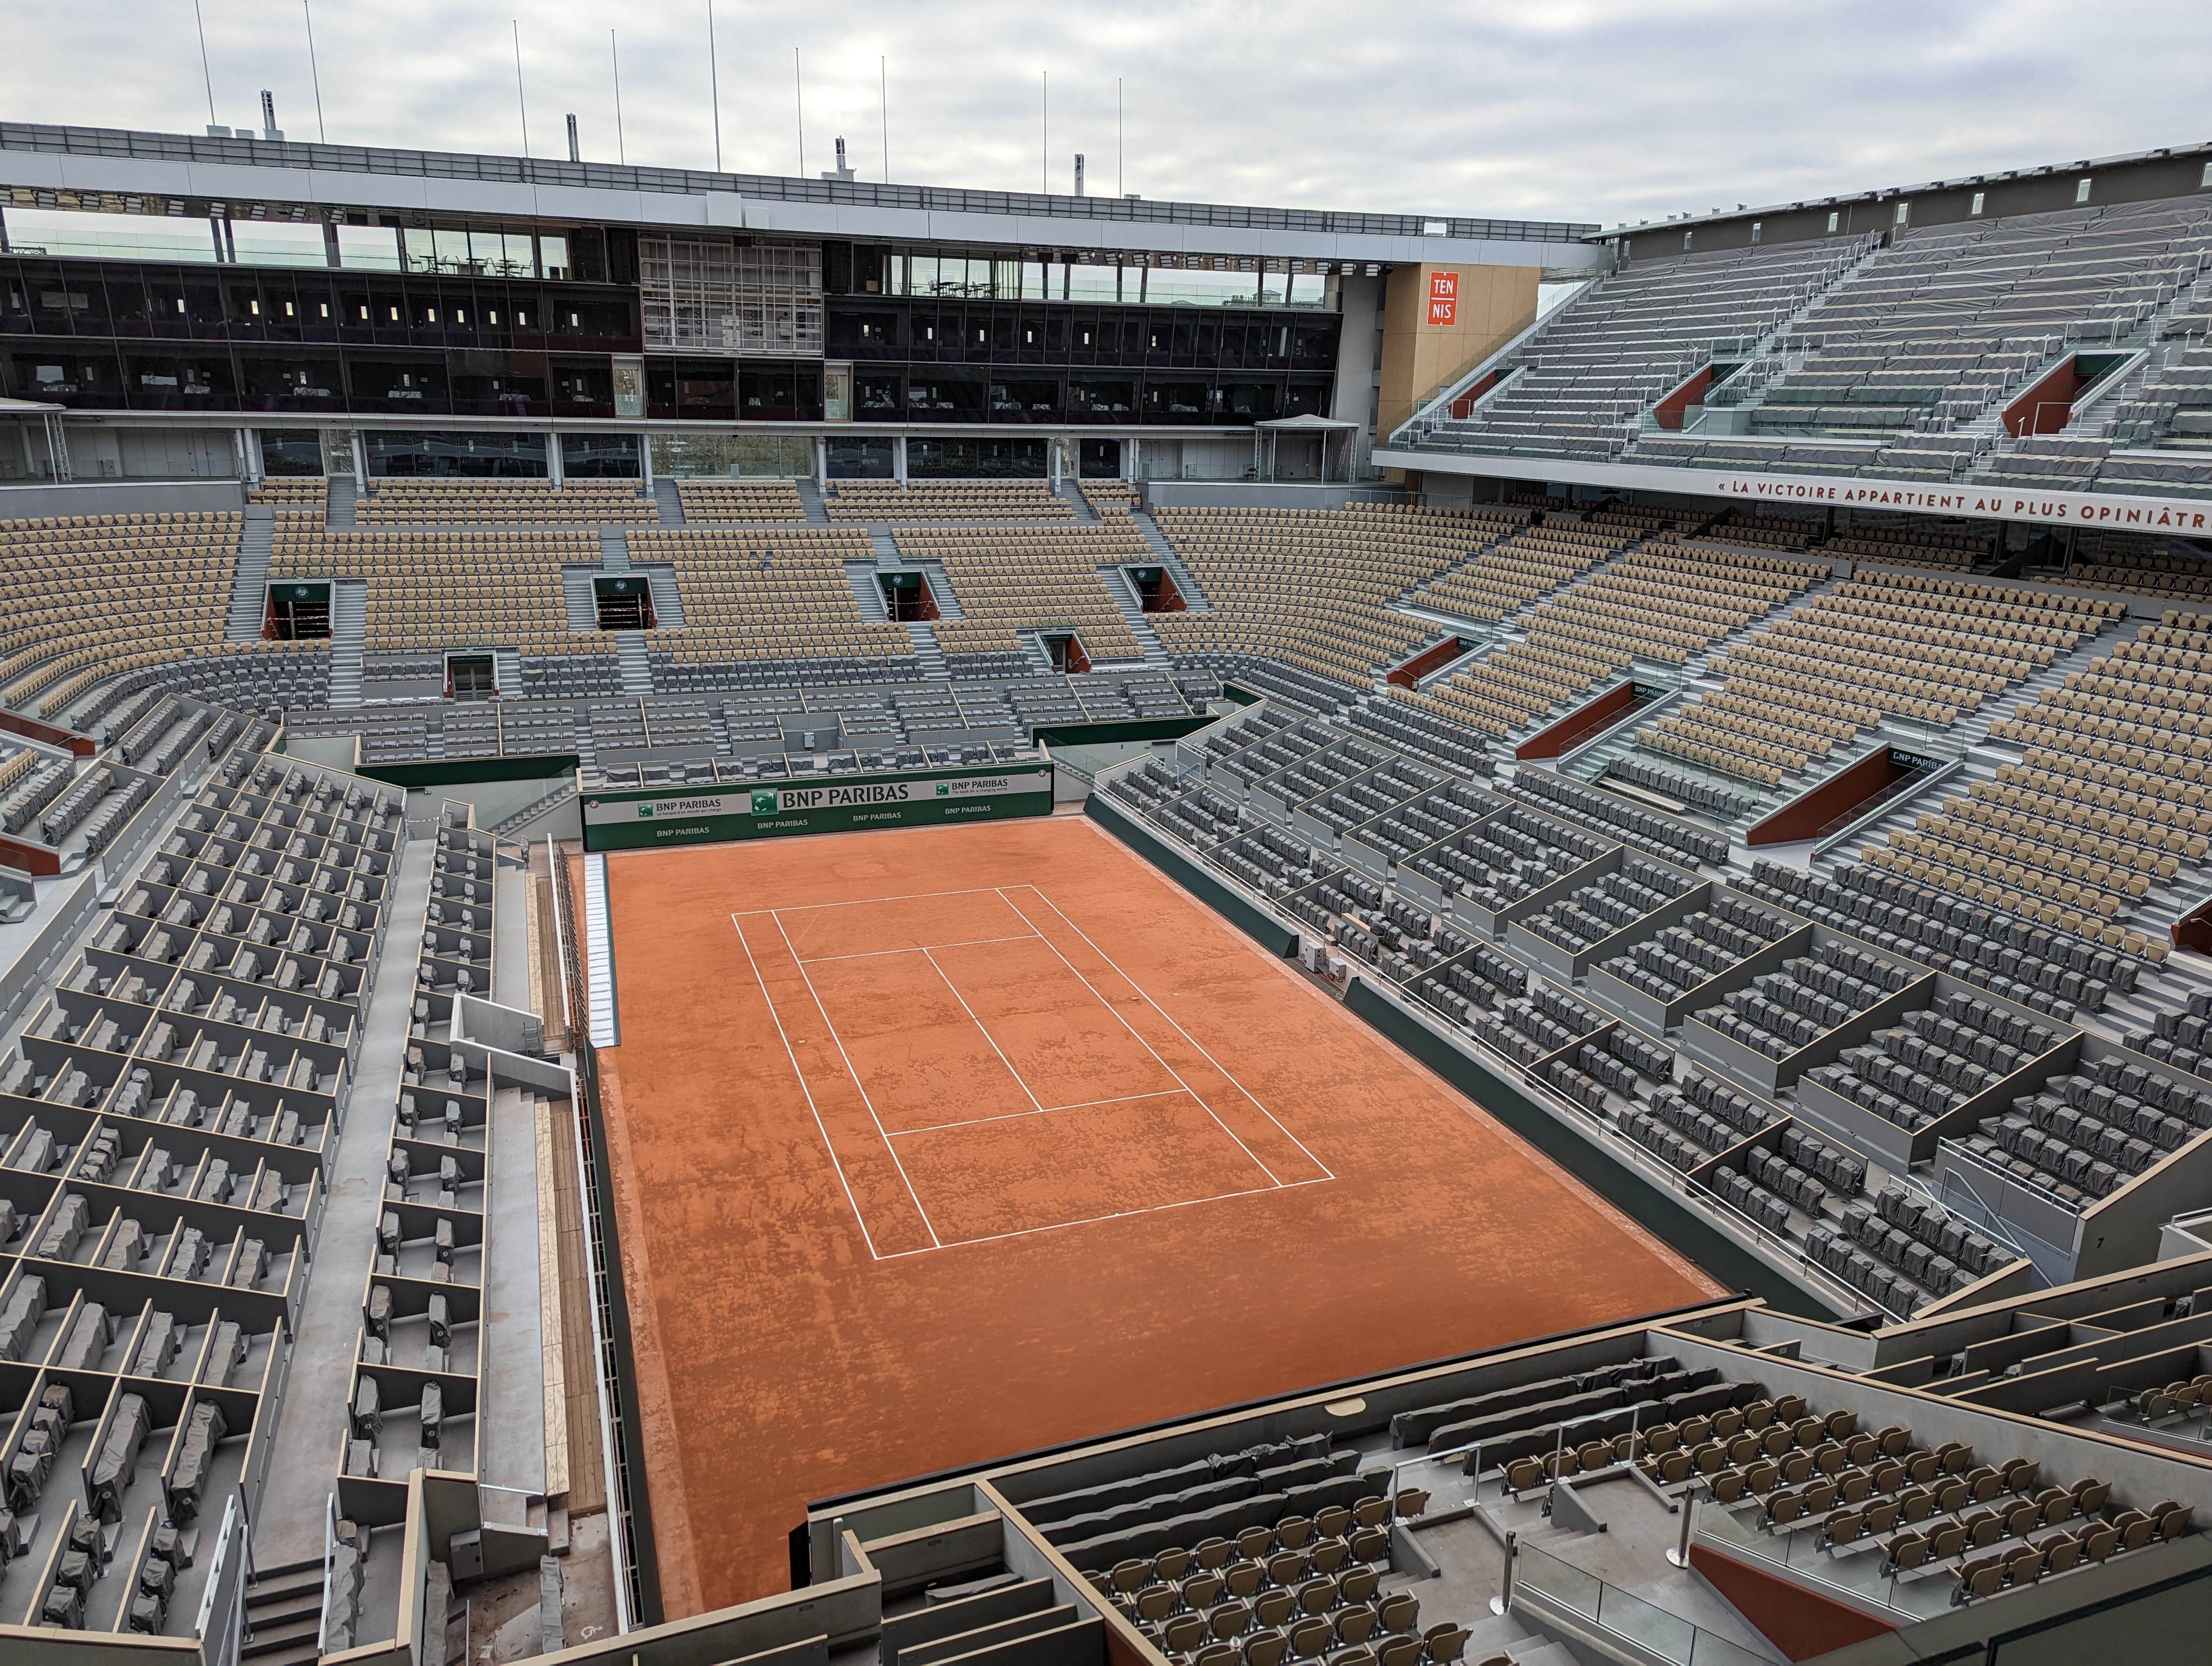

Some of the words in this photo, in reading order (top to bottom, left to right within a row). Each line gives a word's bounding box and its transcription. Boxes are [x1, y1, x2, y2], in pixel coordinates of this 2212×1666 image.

[1434, 279, 1454, 294] TEN
[1432, 304, 1451, 318] NIS
[1733, 480, 1748, 492] LA
[1757, 483, 1836, 499] VICTOIRE
[1844, 489, 1965, 509] APPARTIENT
[1975, 498, 2002, 512] AU
[2014, 500, 2067, 517] PLUS
[2080, 505, 2212, 528] OPINIÂTR
[1912, 756, 1945, 770] PARIBA
[951, 781, 970, 790] BNP
[972, 779, 1008, 789] PARIBAS
[782, 790, 823, 808] BNP
[828, 784, 909, 805] PARIBAS
[657, 802, 677, 811] BNP
[679, 799, 721, 810] PARIBAS
[961, 805, 991, 813] PARIBAS
[870, 812, 902, 821] PARIBAS
[775, 819, 808, 828] PARIBAS
[676, 826, 710, 836] PARIBAS
[2097, 1238, 2104, 1248] 7
